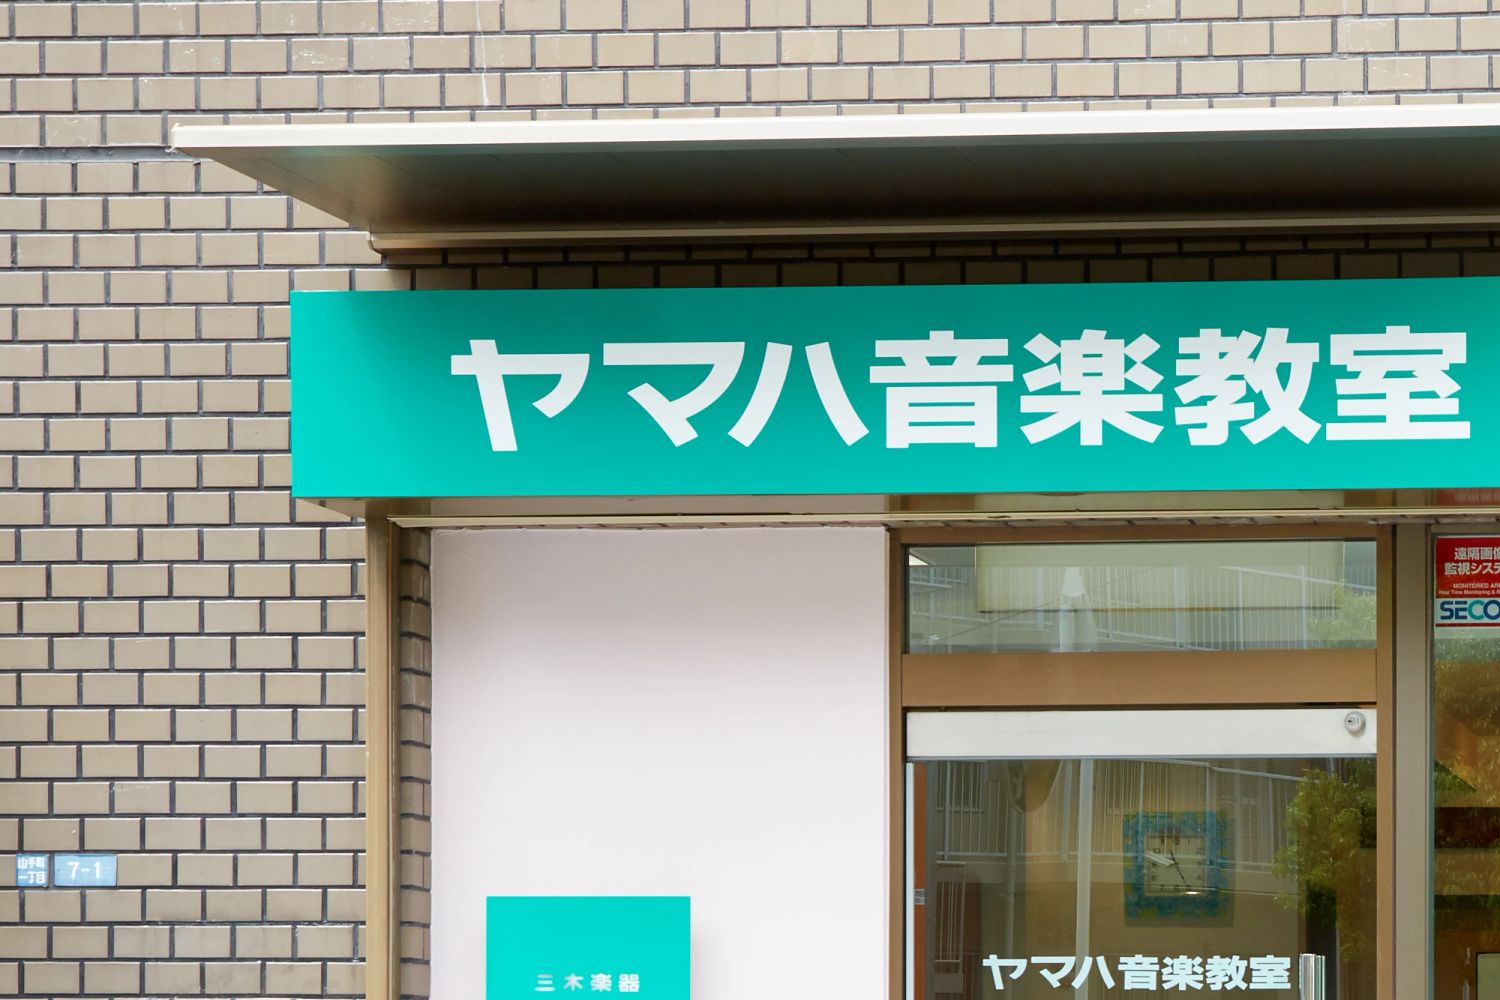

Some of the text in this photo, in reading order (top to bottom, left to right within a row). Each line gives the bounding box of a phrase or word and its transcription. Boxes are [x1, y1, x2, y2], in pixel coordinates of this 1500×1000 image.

[450, 325, 1471, 452] ヤマハ音楽教室
[17, 871, 45, 884] 一丁目
[67, 861, 102, 880] 7-1
[982, 953, 1292, 991] ヤマハ音楽教室
[534, 973, 641, 993] 三木楽器
